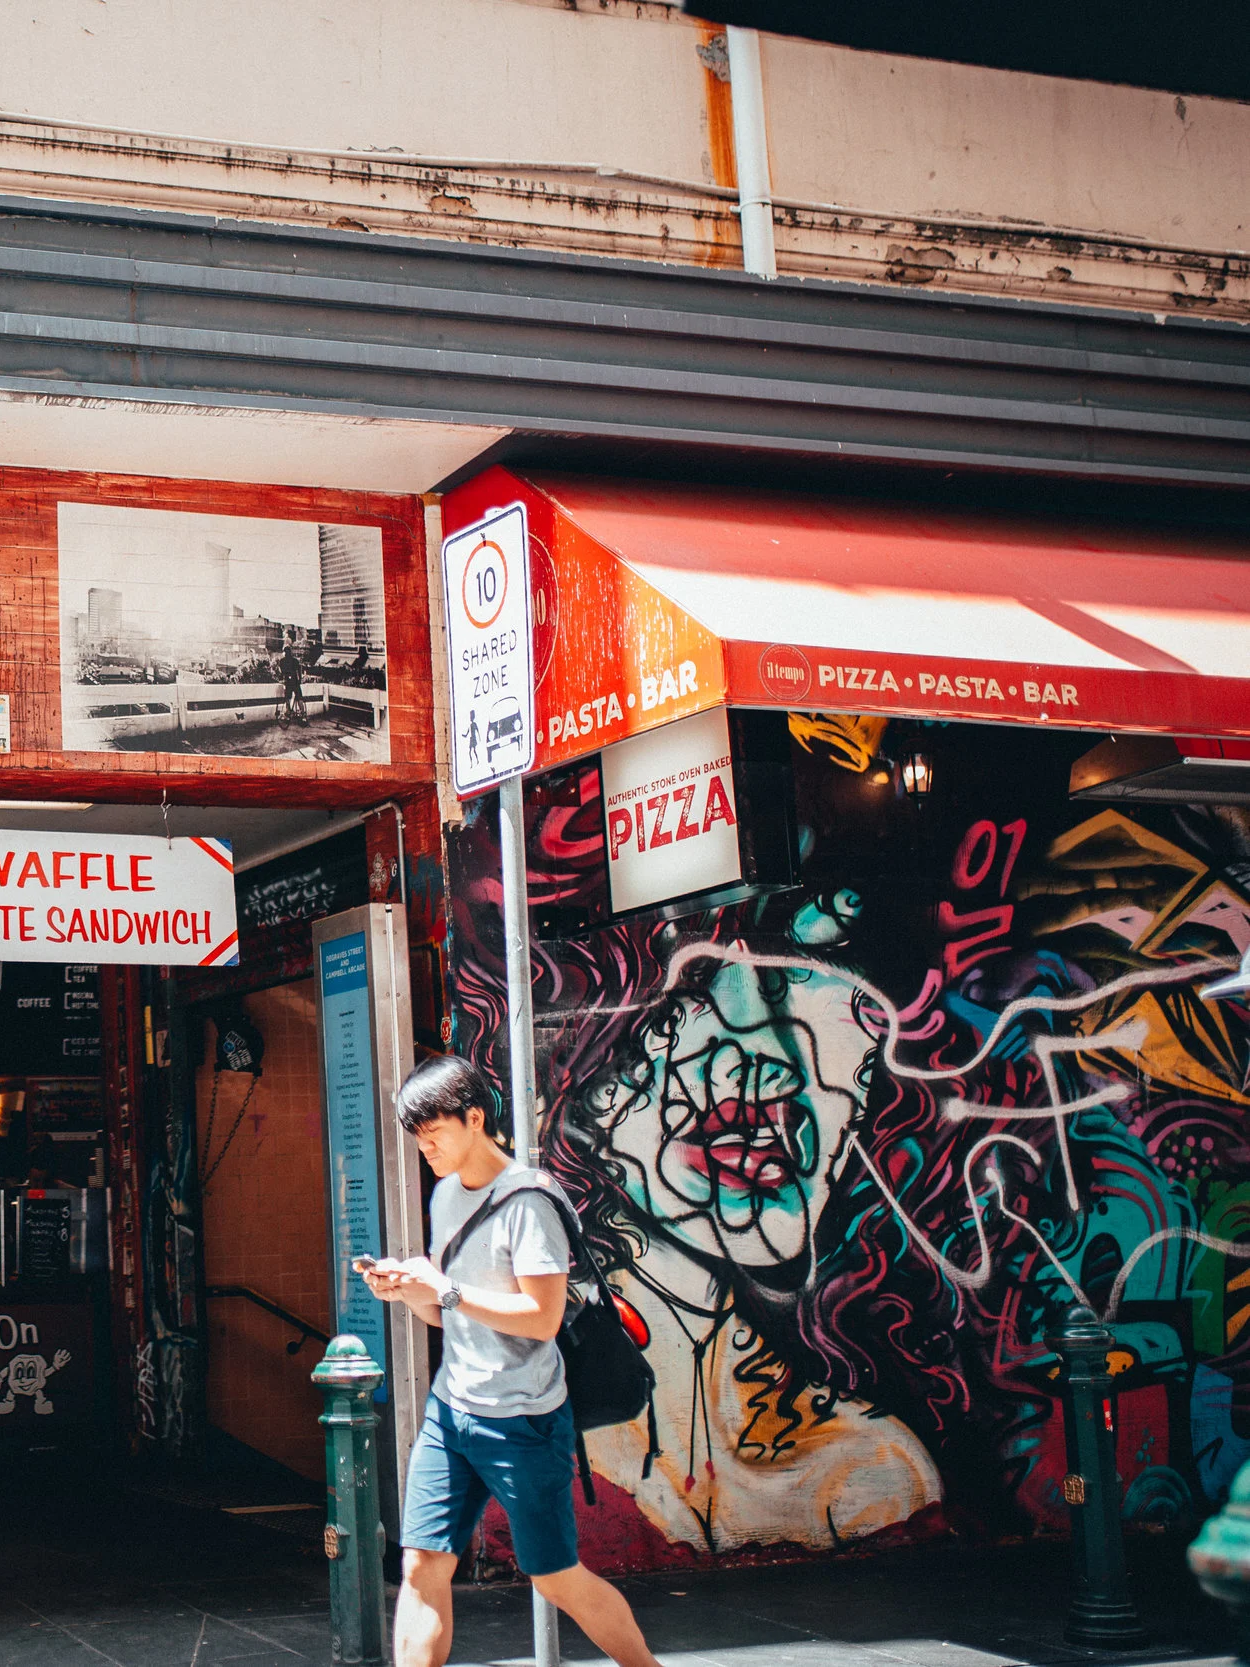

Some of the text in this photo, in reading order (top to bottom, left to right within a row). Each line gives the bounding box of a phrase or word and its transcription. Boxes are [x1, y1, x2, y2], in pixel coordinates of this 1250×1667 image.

[475, 566, 496, 607] 10
[461, 629, 517, 672] SHARED
[472, 664, 508, 699] ZONE
[818, 665, 1079, 706] PIZZA PASTA BAR
[548, 660, 698, 748] PASTA BAR
[607, 755, 732, 807] AUTHENTIC STONE OVEN BAKED
[608, 775, 737, 861] PIZZA
[44, 906, 213, 946] SANDWICH
[325, 963, 365, 979] CAMPBELL ARCADE
[340, 959, 349, 967] AND
[347, 946, 364, 956] STREET
[17, 998, 50, 1008] COFFEE
